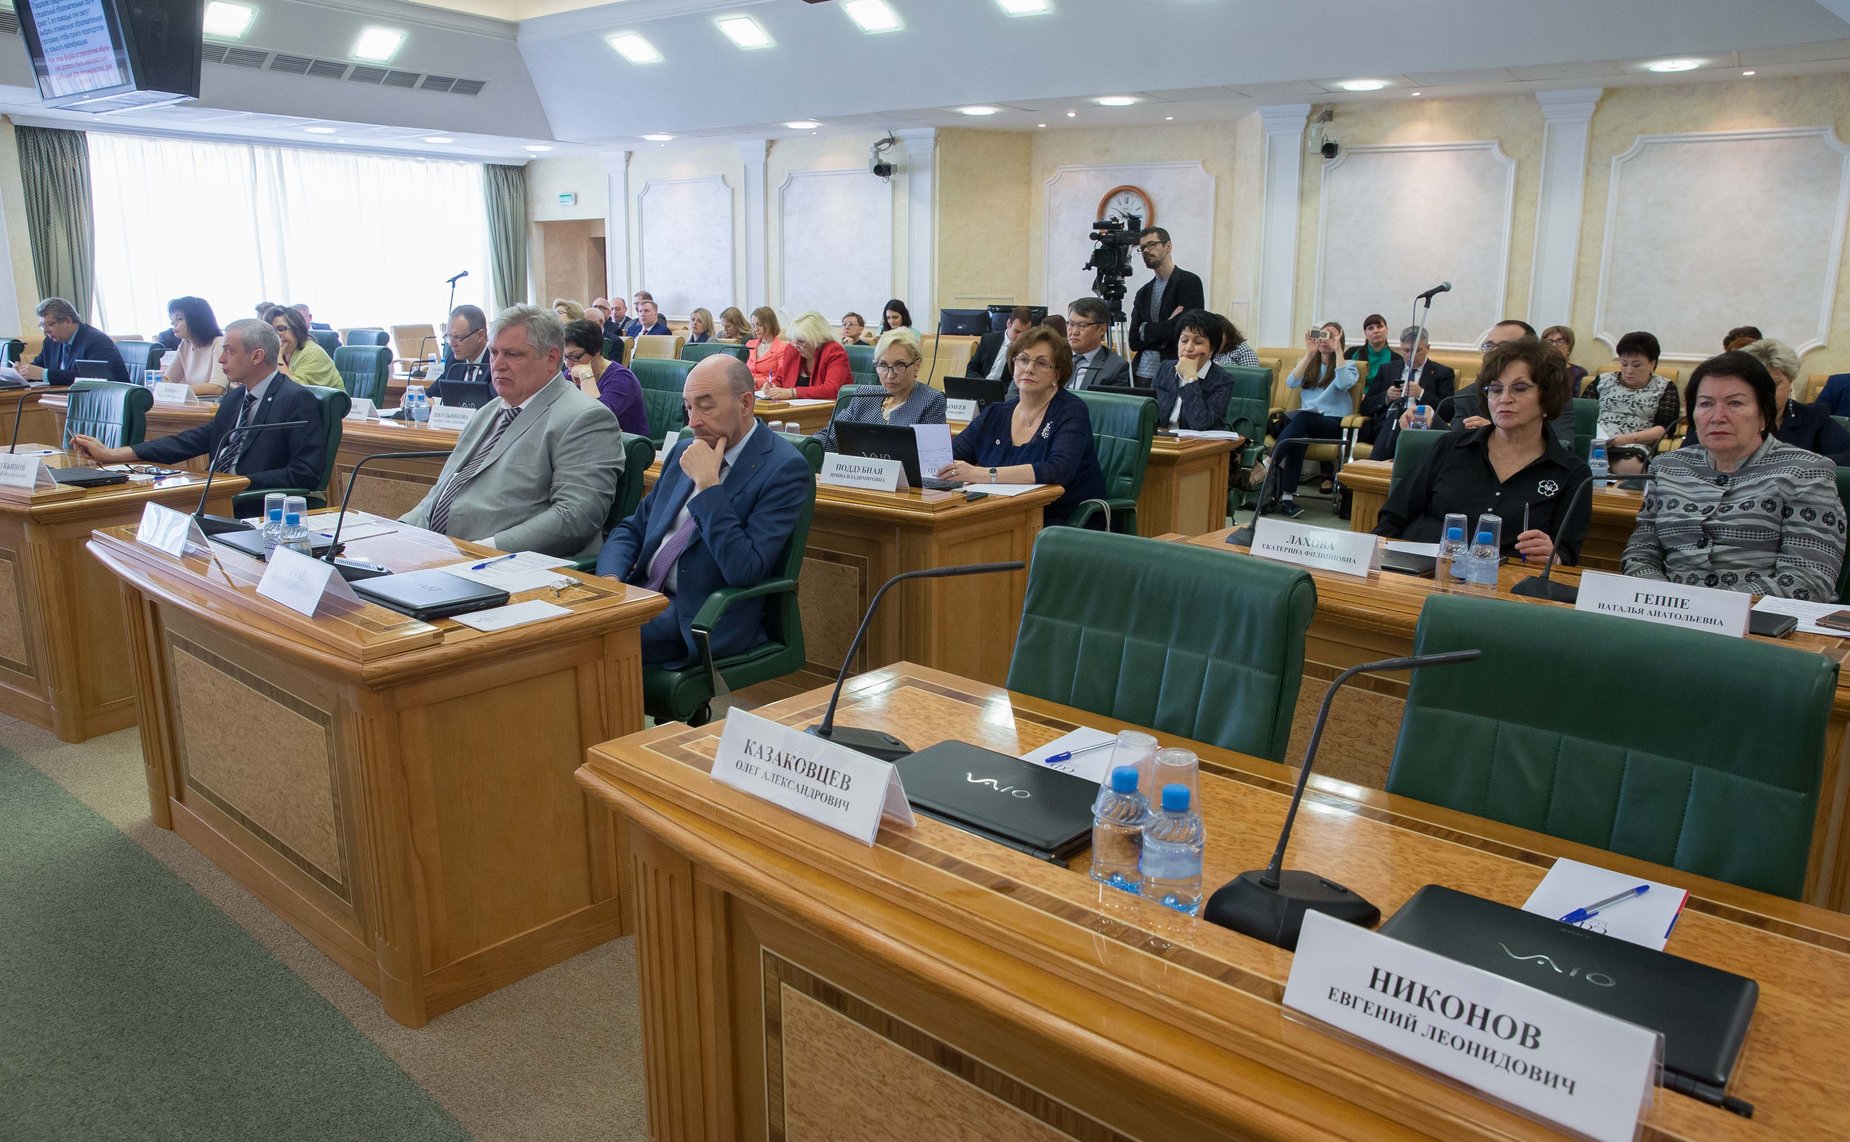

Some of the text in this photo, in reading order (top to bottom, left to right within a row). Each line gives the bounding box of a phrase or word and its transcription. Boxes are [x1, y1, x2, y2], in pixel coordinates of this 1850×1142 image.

[835, 463, 883, 475] ПОДДУБНАЯ
[1261, 543, 1357, 565] ЕКАТЕРИНА ФИЛИППОВНА
[1286, 534, 1335, 551] ЛАХОВА
[1598, 602, 1724, 627] НАТАЛЬЯ АНАТОЛЬЕВНА
[1634, 592, 1690, 610] ГЕППЕ
[743, 738, 852, 792] КАЗАКОВЦЕВ
[735, 760, 851, 812] ОЛЕГ АЛЕКСАНДРОВИЧ
[966, 772, 1032, 799] VAIO
[1499, 942, 1616, 988] VAIO
[1368, 966, 1542, 1051] НИКОНОВ
[1327, 986, 1577, 1097] ЕВГЕНИЙ ЛЕОНИДОВИЧ
